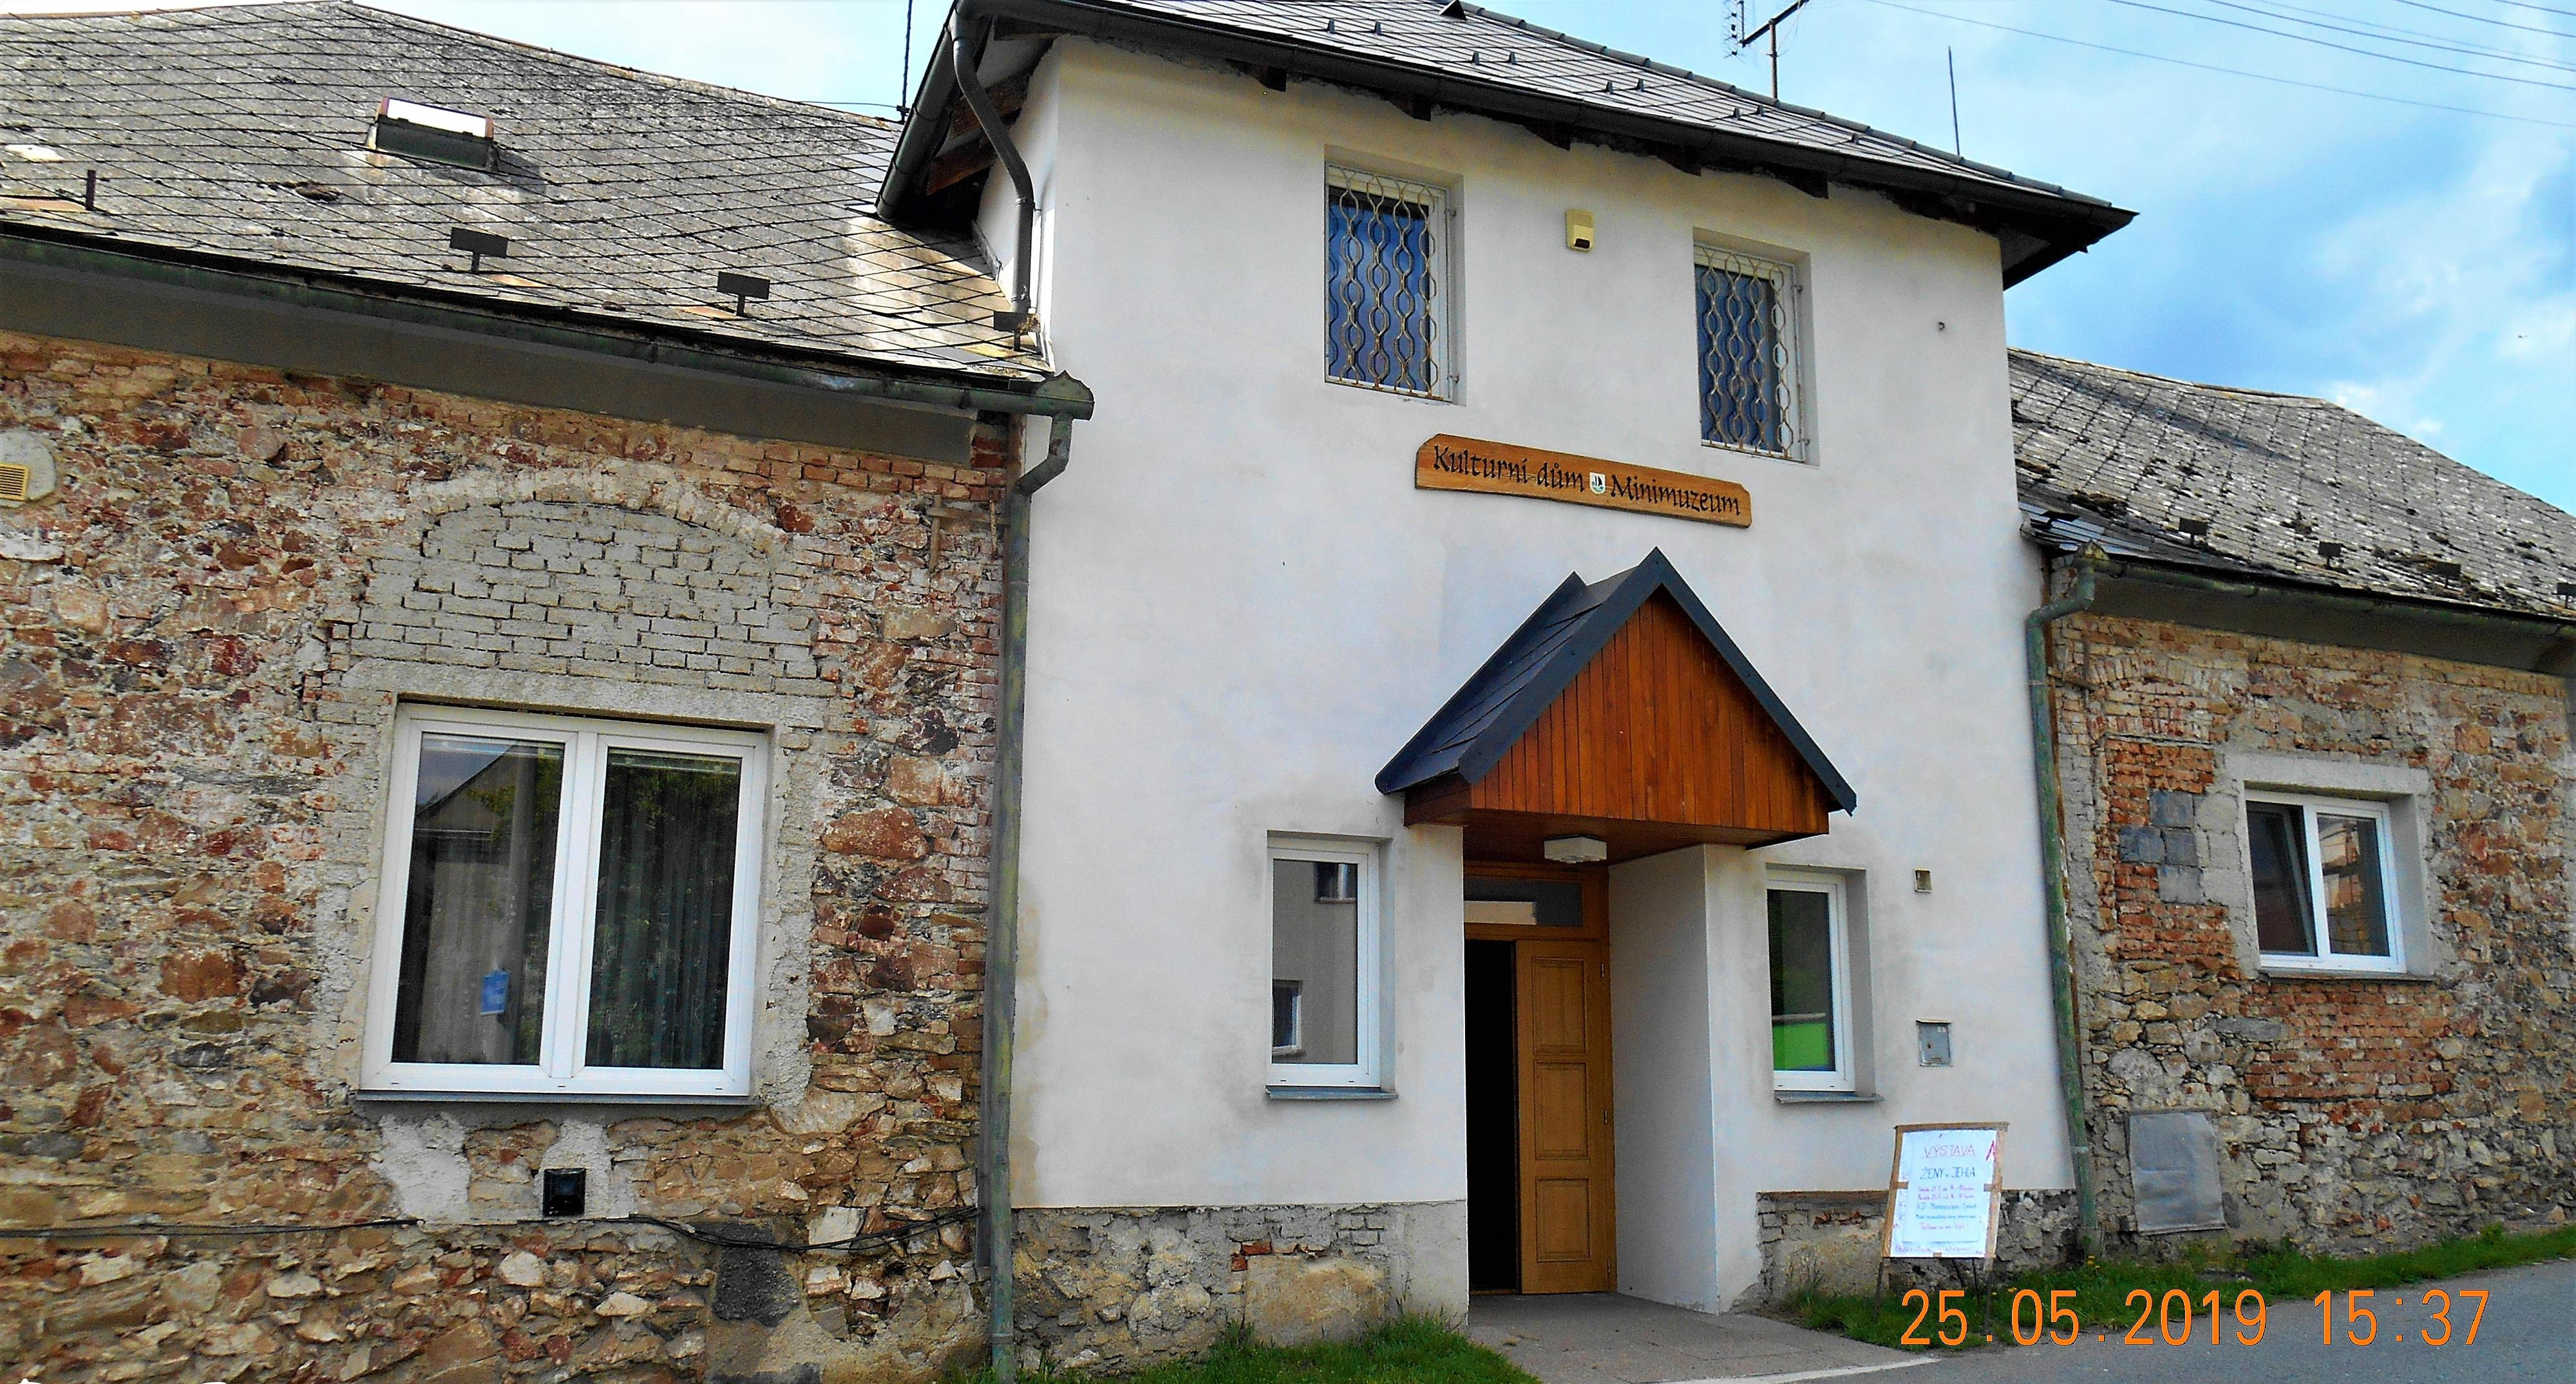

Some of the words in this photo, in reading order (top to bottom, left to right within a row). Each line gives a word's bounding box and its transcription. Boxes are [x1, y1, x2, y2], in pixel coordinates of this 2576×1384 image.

[1434, 444, 1529, 484] Kulturní
[1537, 462, 1586, 493] dům
[1610, 474, 1741, 516] Minimuzeum
